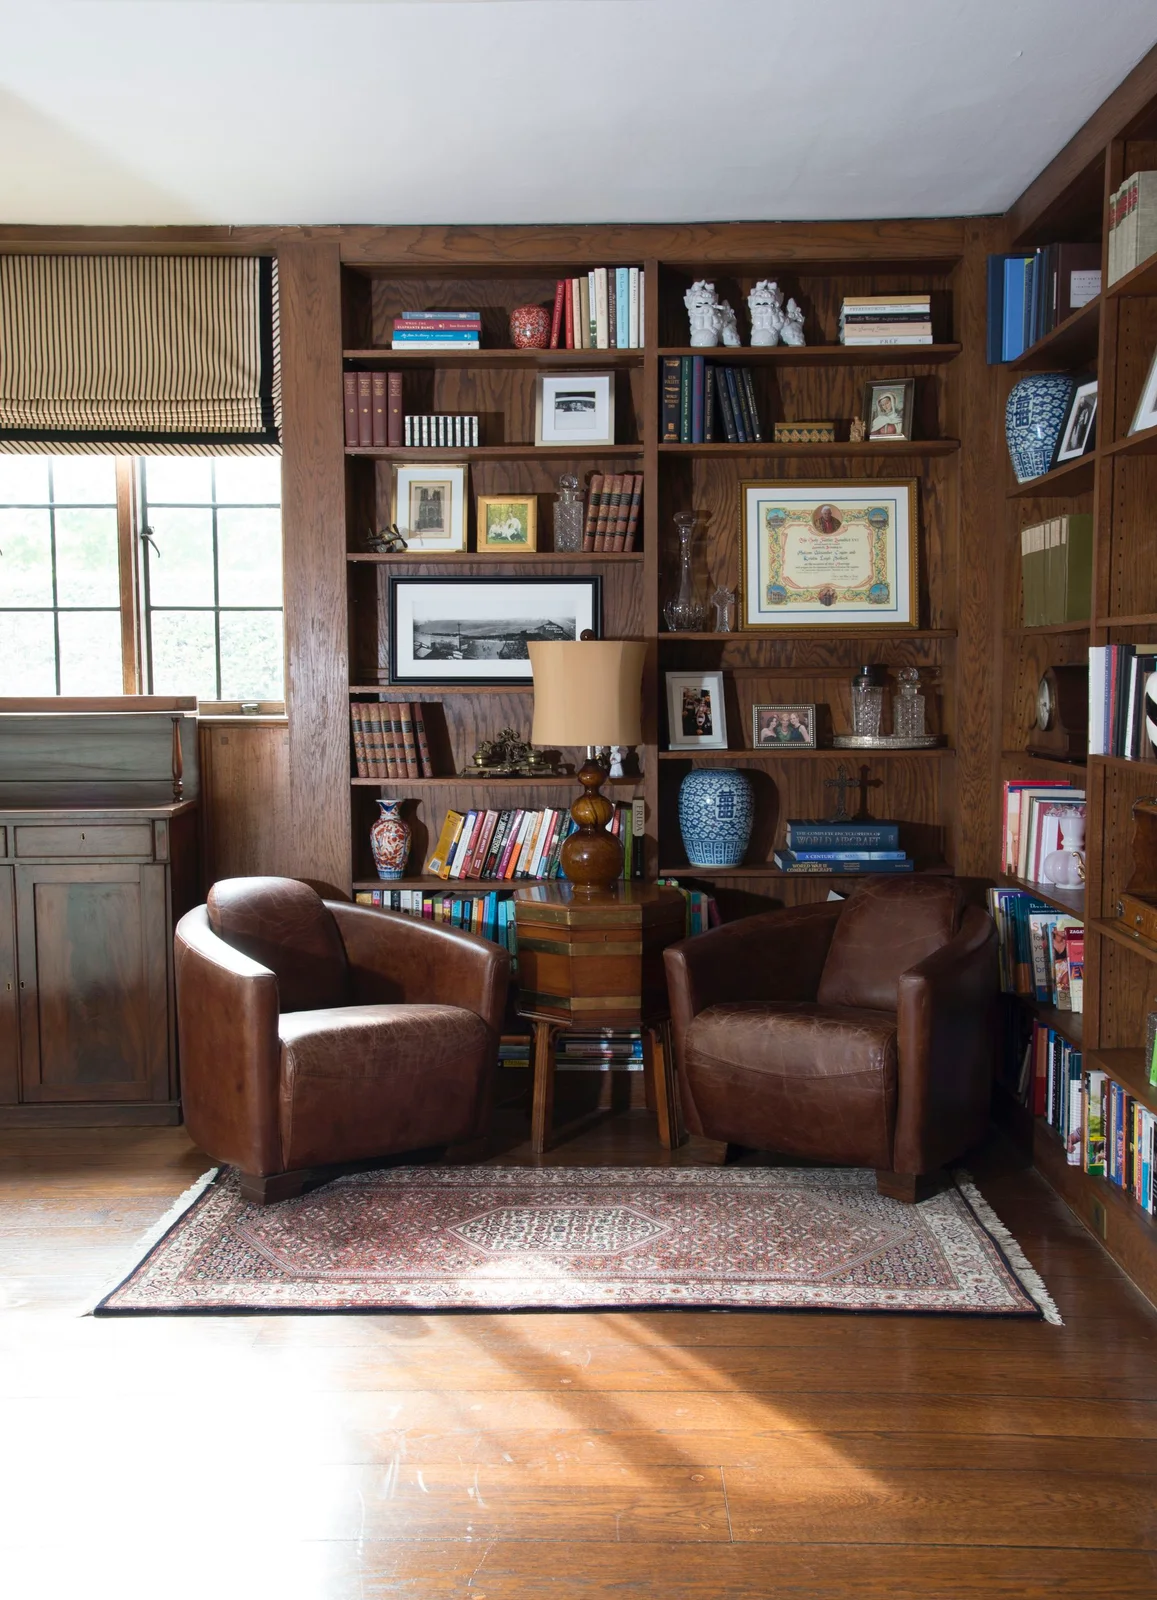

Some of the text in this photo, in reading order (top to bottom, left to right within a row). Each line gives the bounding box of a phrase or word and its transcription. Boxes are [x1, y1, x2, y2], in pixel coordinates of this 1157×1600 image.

[491, 833, 504, 855] PATTERSON
[796, 836, 881, 846] WORLD AIRCRAFT
